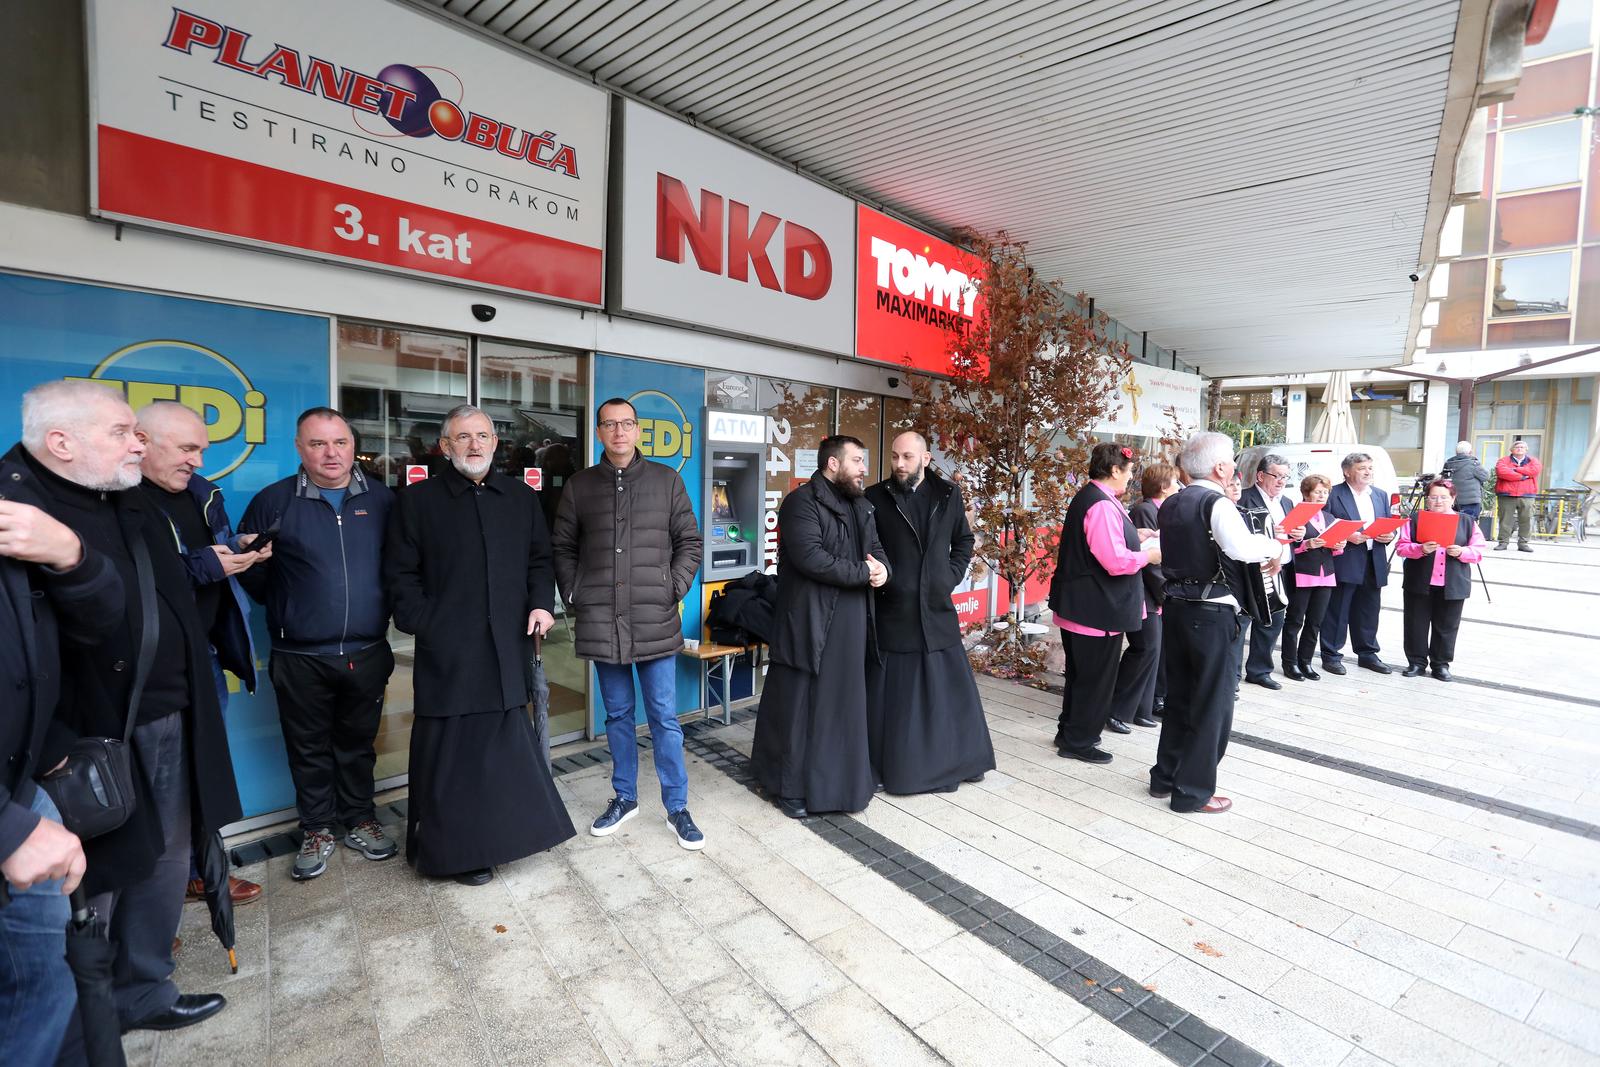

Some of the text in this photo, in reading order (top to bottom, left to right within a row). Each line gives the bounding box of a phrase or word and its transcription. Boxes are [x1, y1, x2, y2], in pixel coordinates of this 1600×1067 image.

[162, 7, 417, 119] PLANET
[165, 91, 579, 221] TESTIRANO KORAKOM
[333, 204, 472, 265] 3. kat
[656, 171, 833, 301] NKD
[871, 236, 982, 317] TOMMY
[636, 417, 692, 458] EDi
[714, 418, 758, 436] ATM
[765, 416, 792, 476] 24
[953, 597, 979, 615] emlje
